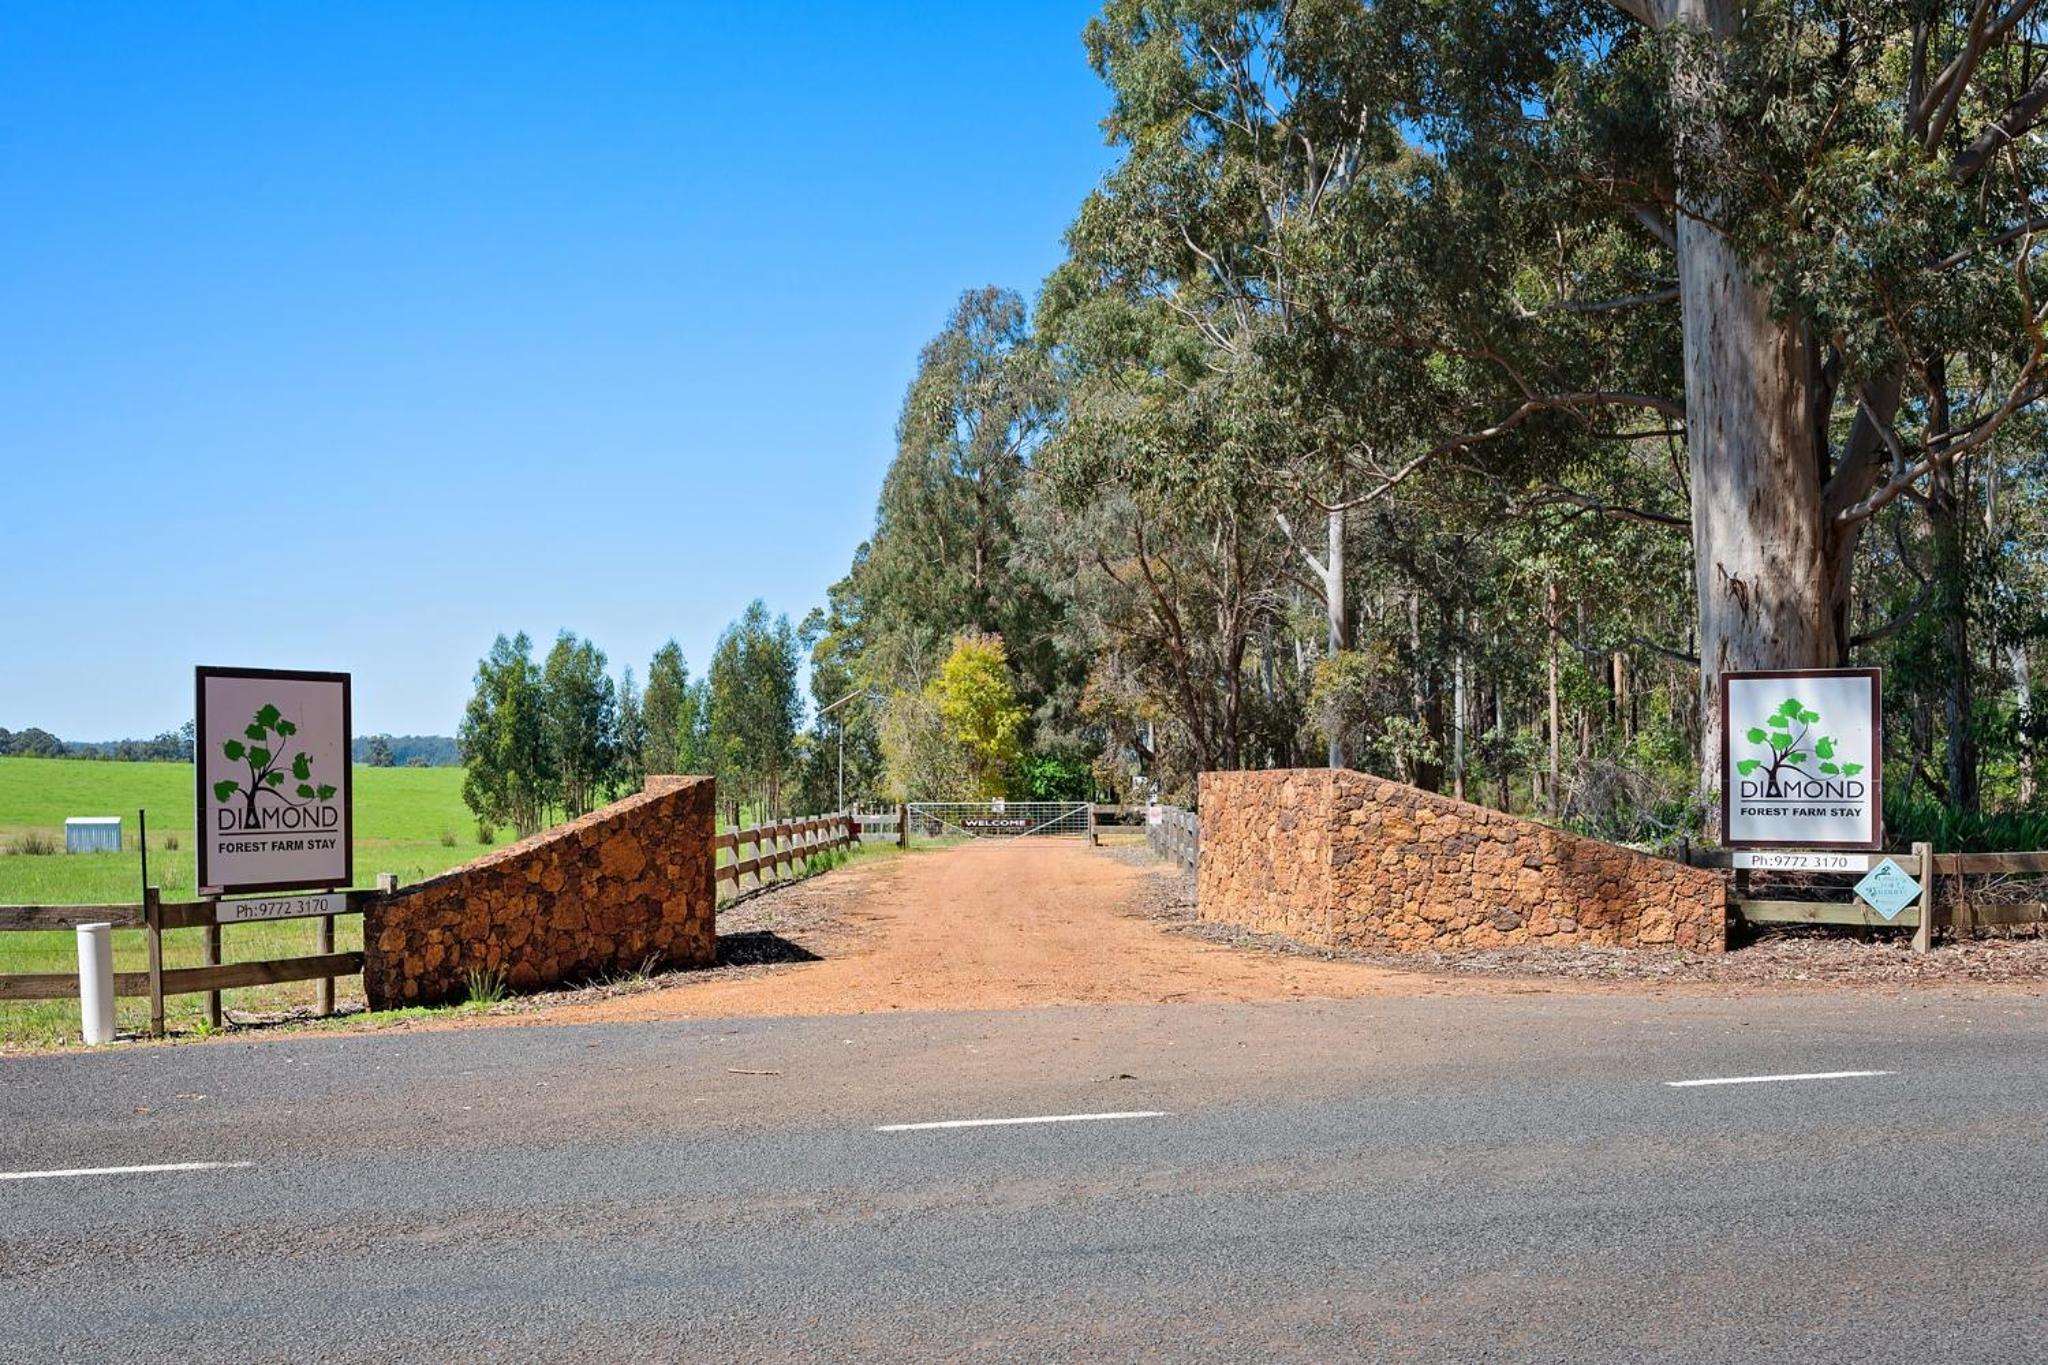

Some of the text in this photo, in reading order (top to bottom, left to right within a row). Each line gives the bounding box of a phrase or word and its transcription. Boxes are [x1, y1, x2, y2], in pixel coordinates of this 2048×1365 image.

[1741, 780, 1864, 798] DIAMOND
[218, 806, 338, 831] DIAMOND
[1740, 807, 1862, 817] FOREST FARM STAY
[218, 839, 337, 854] FOREST FARM STAY
[1813, 856, 1848, 868] 3170
[296, 899, 329, 914] 3170
